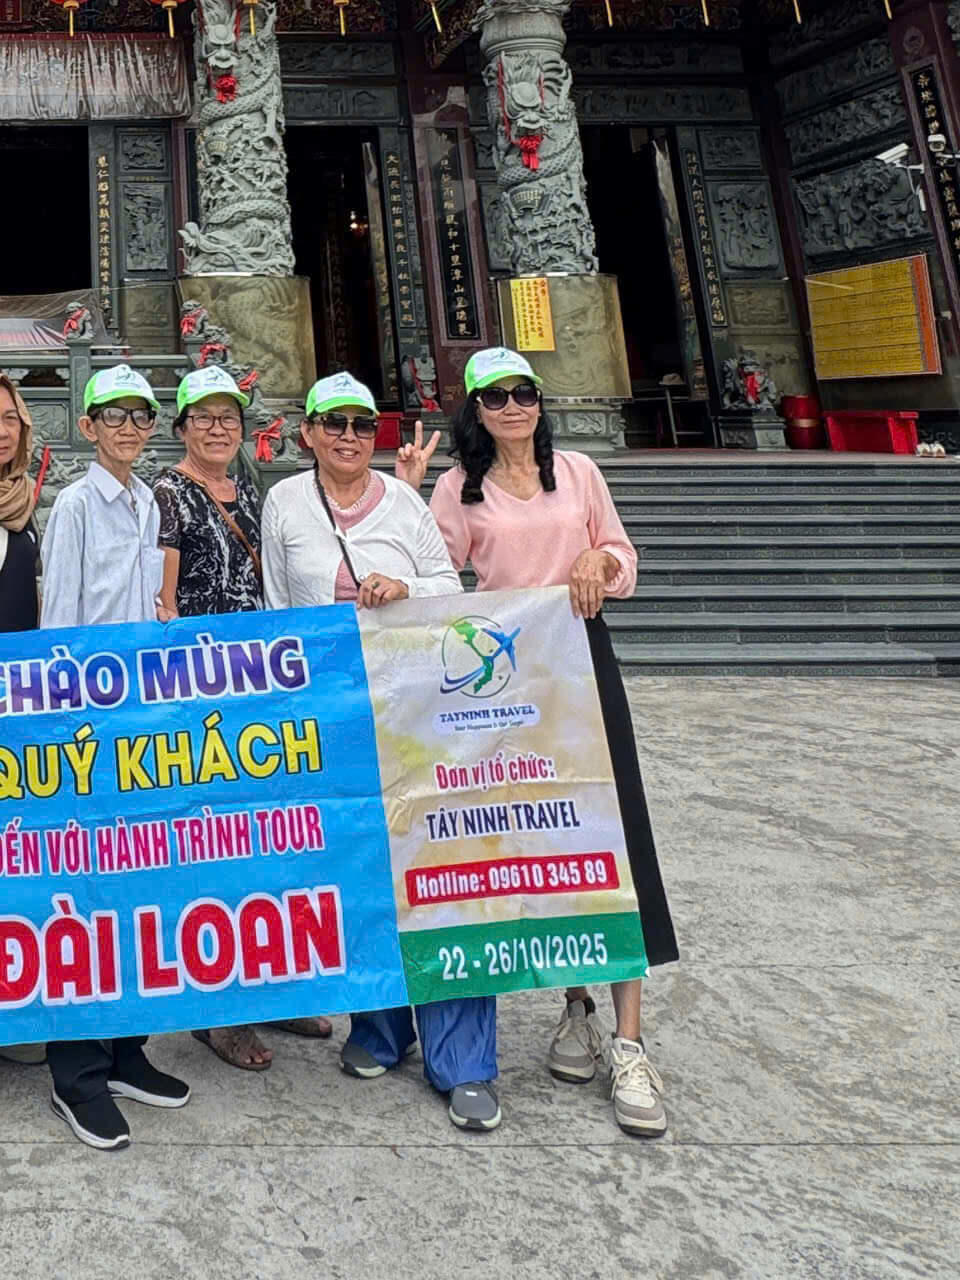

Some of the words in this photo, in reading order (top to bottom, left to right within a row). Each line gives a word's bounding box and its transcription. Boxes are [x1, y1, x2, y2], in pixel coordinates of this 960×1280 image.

[141, 634, 308, 703] MỪNG
[439, 709, 490, 723] TAYNINH
[491, 705, 535, 718] TRAVEL
[115, 711, 322, 792] KHÁCH
[436, 762, 471, 789] Đơn
[472, 763, 487, 792] vị
[489, 753, 507, 783] tổ
[508, 756, 555, 782] chức:
[46, 821, 91, 874] VỚI
[96, 818, 169, 872] HÀNH
[175, 808, 251, 862] TRÌNH
[255, 806, 324, 853] TOUR
[427, 806, 461, 840] TÂY
[463, 805, 510, 837] NINH
[512, 801, 580, 832] TRAVEL
[416, 872, 486, 899] Hotline:
[548, 861, 581, 888] 345
[585, 858, 607, 885] 89
[139, 892, 342, 990] LOAN
[439, 946, 468, 981] 22
[485, 932, 608, 977] 26/10/2025
